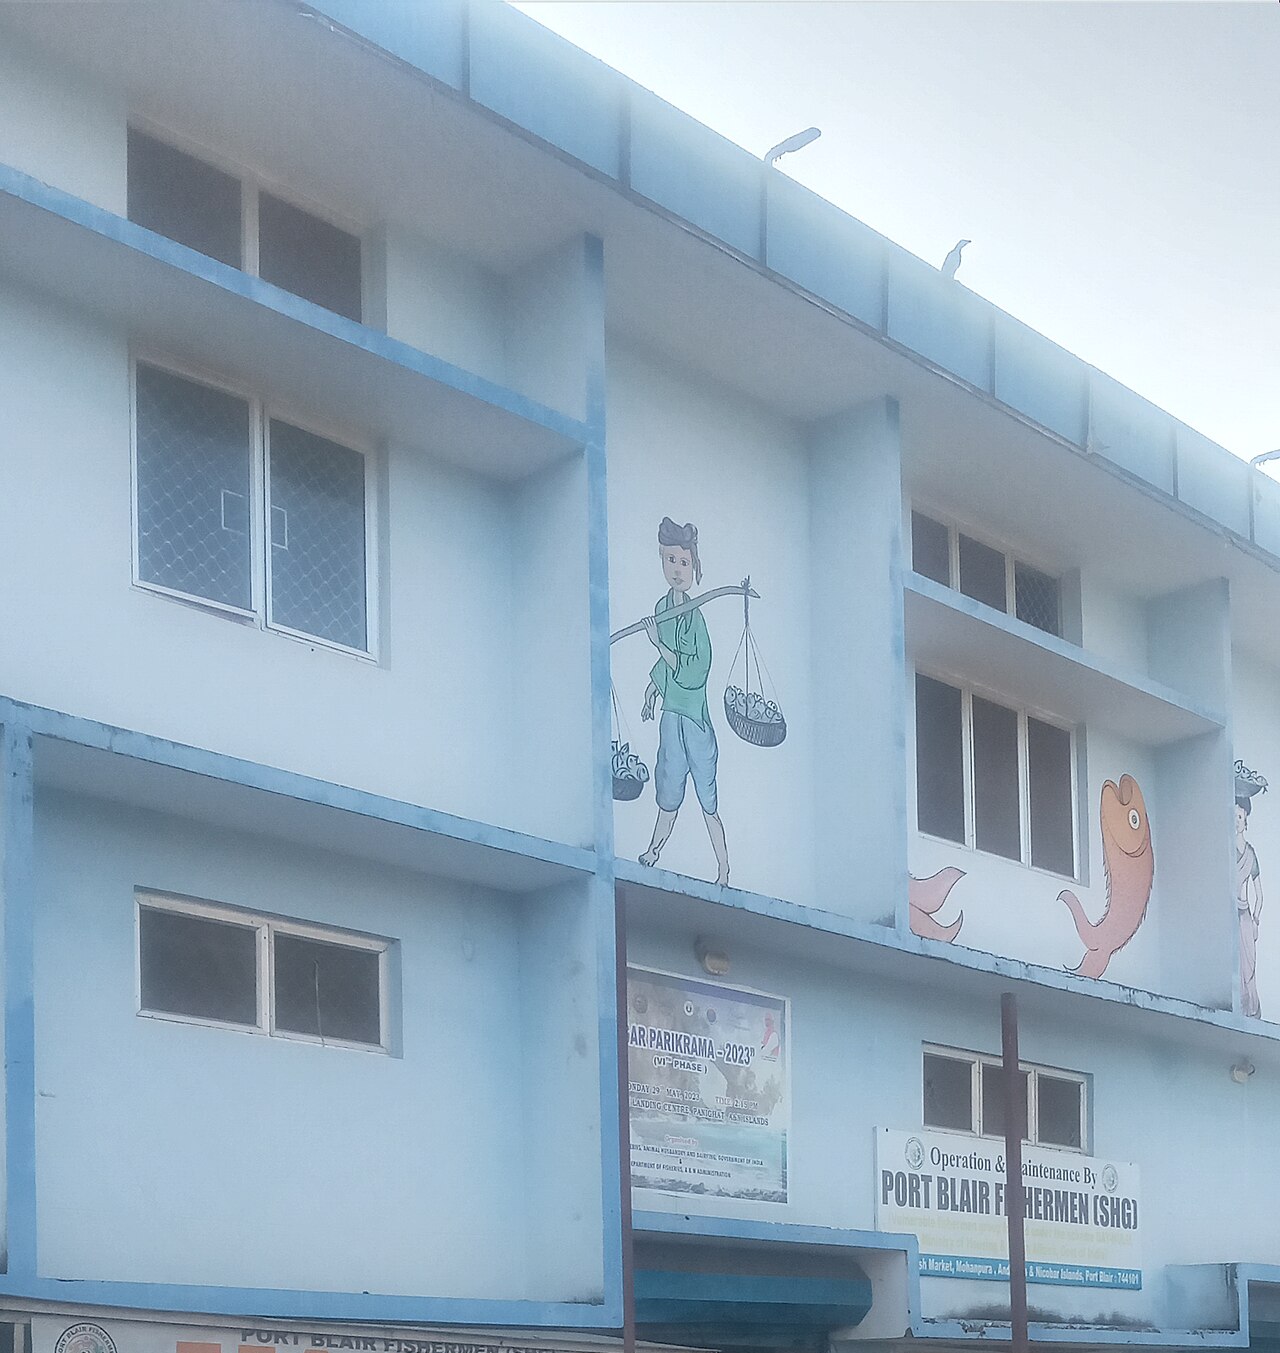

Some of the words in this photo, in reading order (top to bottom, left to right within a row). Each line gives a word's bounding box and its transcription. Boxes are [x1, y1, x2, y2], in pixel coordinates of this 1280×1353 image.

[628, 1025, 647, 1047] AR
[649, 1029, 715, 1059] PARIKRAMA
[674, 1060, 702, 1072] PHASE
[628, 1082, 649, 1094] ONDAY
[685, 1091, 700, 1101] 2023
[632, 1098, 662, 1110] LANDING
[743, 1115, 769, 1126] ISLANDS
[930, 1146, 991, 1171] Operation
[995, 1154, 1006, 1173] &
[1022, 1159, 1081, 1182] aintenance
[1083, 1167, 1098, 1190] By
[882, 1170, 932, 1209] PORT
[937, 1176, 990, 1215] BLAIR
[995, 1183, 1089, 1225] FIHERMEN
[1093, 1195, 1138, 1230] (SHG)
[918, 1258, 927, 1271] sh
[928, 1258, 955, 1274] Market,
[956, 1260, 992, 1276] Mohanpura
[1029, 1265, 1035, 1277] &
[1036, 1266, 1060, 1280] Nicobar
[1061, 1269, 1085, 1284] Islands,
[1086, 1270, 1098, 1283] Port
[1099, 1272, 1113, 1284] Blair
[1118, 1272, 1139, 1285] 744101
[240, 1329, 299, 1346] PORT
[311, 1334, 377, 1352] BLAIR
